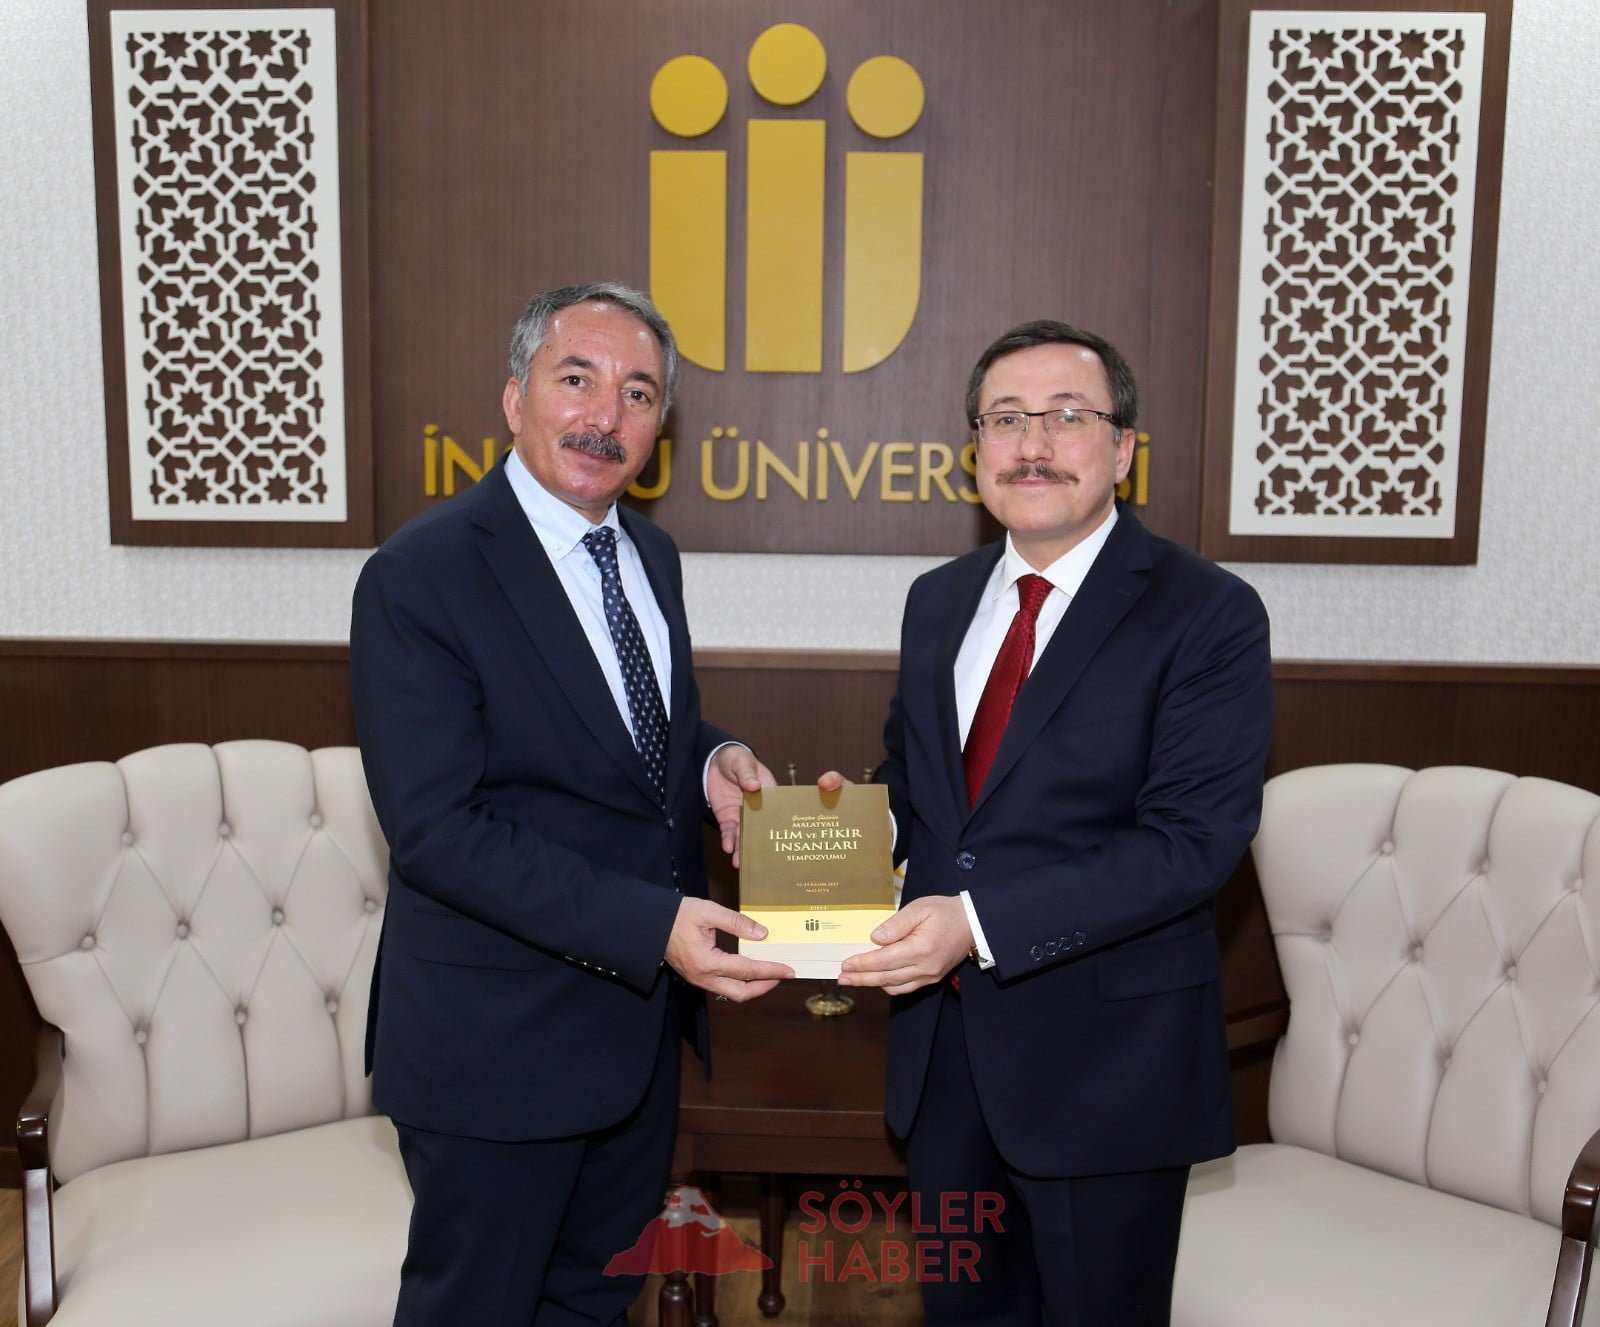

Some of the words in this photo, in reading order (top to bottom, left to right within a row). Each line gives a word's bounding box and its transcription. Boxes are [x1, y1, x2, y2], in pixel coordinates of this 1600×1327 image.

[792, 821, 839, 829] MALATYALI
[769, 829, 803, 840] İLİM
[820, 827, 863, 839] FİKİR
[775, 840, 858, 852] İNSANLARI
[786, 853, 847, 861] SEMPOZYUMU
